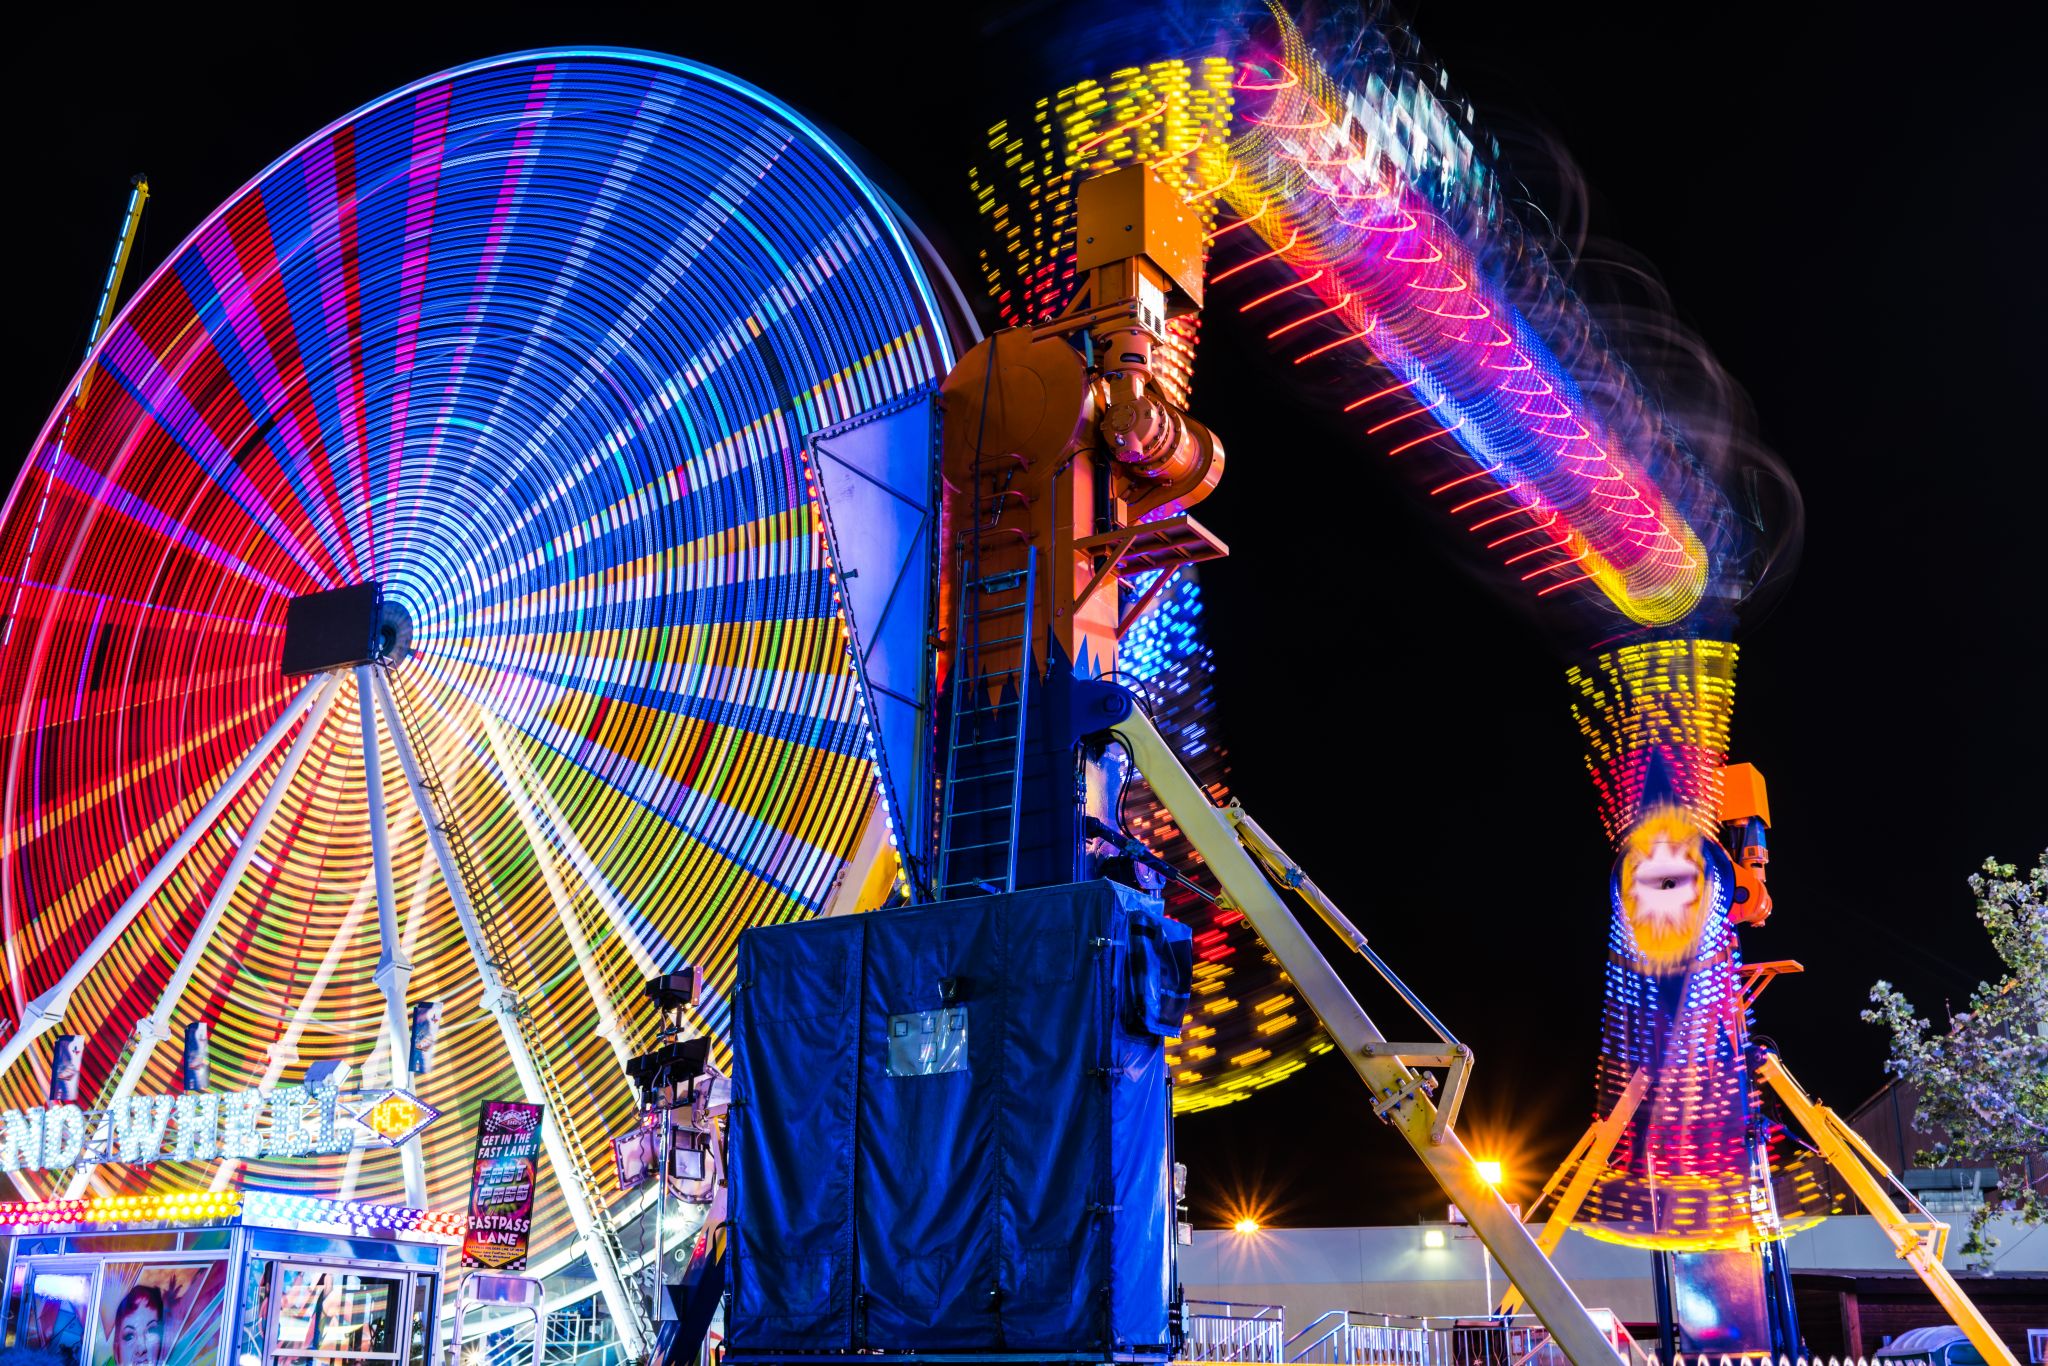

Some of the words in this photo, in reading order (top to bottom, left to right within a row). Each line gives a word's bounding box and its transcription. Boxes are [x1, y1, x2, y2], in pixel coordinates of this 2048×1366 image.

[113, 1085, 354, 1163] WHEEL
[482, 1135, 500, 1147] GET
[501, 1134, 512, 1145] IN
[514, 1132, 531, 1144] THE
[478, 1146, 502, 1159] FAST
[478, 1164, 527, 1186] FAST
[477, 1184, 530, 1206] PASS
[468, 1215, 530, 1233] FASTPASS
[477, 1231, 519, 1246] LANE
